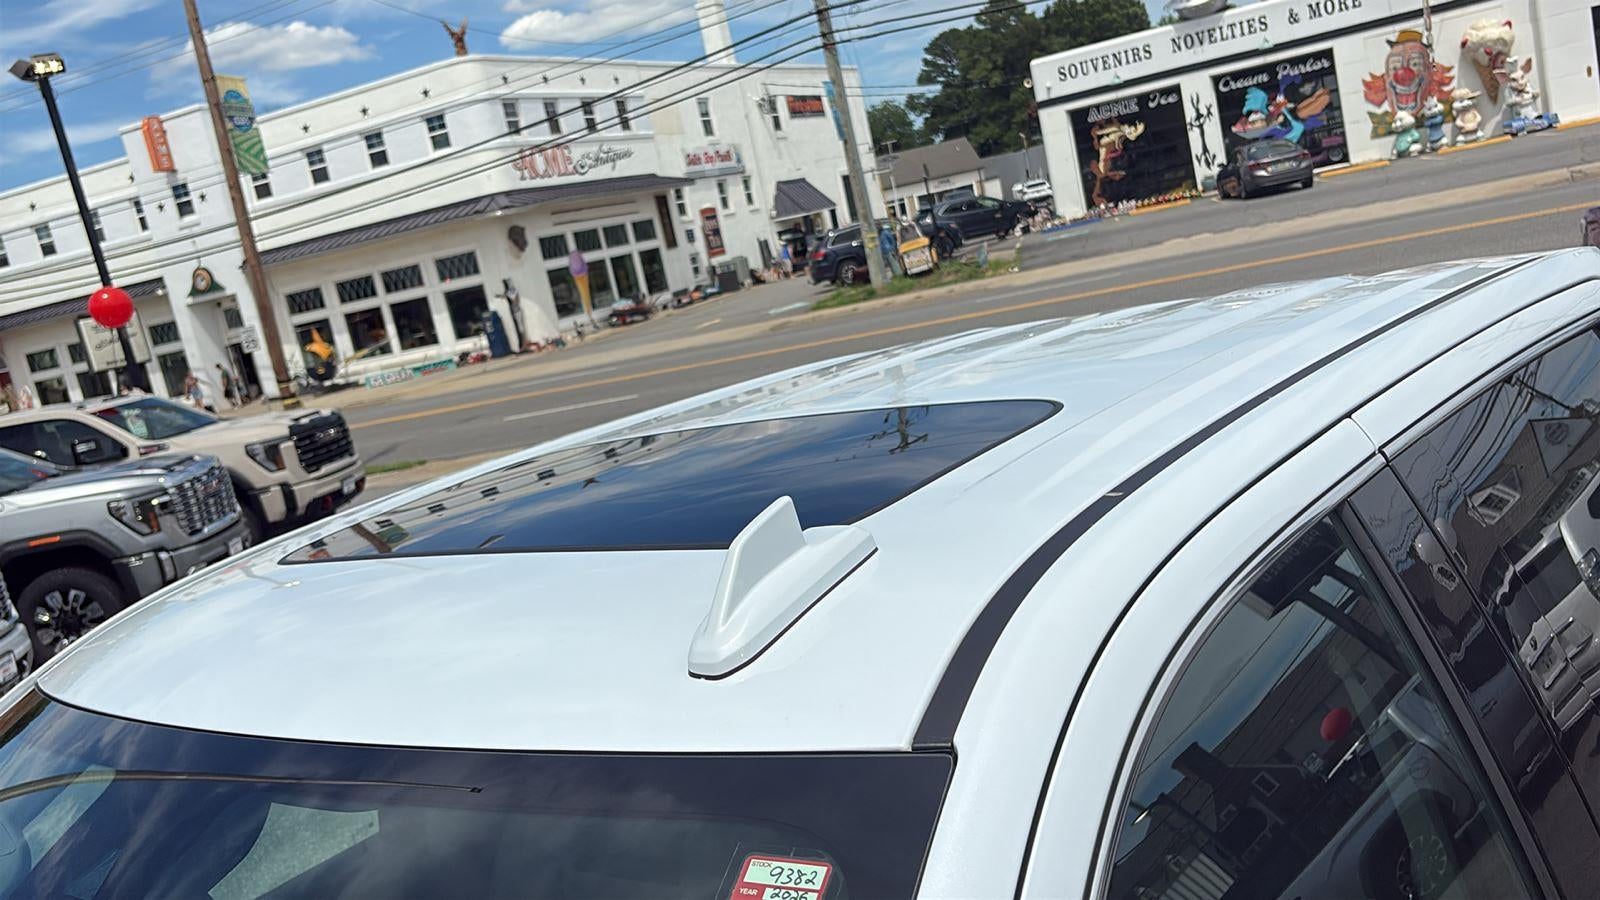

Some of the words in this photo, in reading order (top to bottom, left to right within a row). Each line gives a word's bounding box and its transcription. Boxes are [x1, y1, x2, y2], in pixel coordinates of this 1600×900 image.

[1057, 43, 1153, 82] SOUVENIRS
[1169, 15, 1269, 54] NOVELTIES
[1288, 7, 1300, 25] &
[1307, 0, 1362, 20] MORE
[1218, 72, 1271, 92] Cream
[1276, 57, 1332, 80] Parlor
[1087, 98, 1140, 123] ACME
[1148, 92, 1180, 108] Ice
[512, 144, 576, 180] ACME
[740, 888, 758, 896] YEAR
[769, 866, 818, 885] 9382
